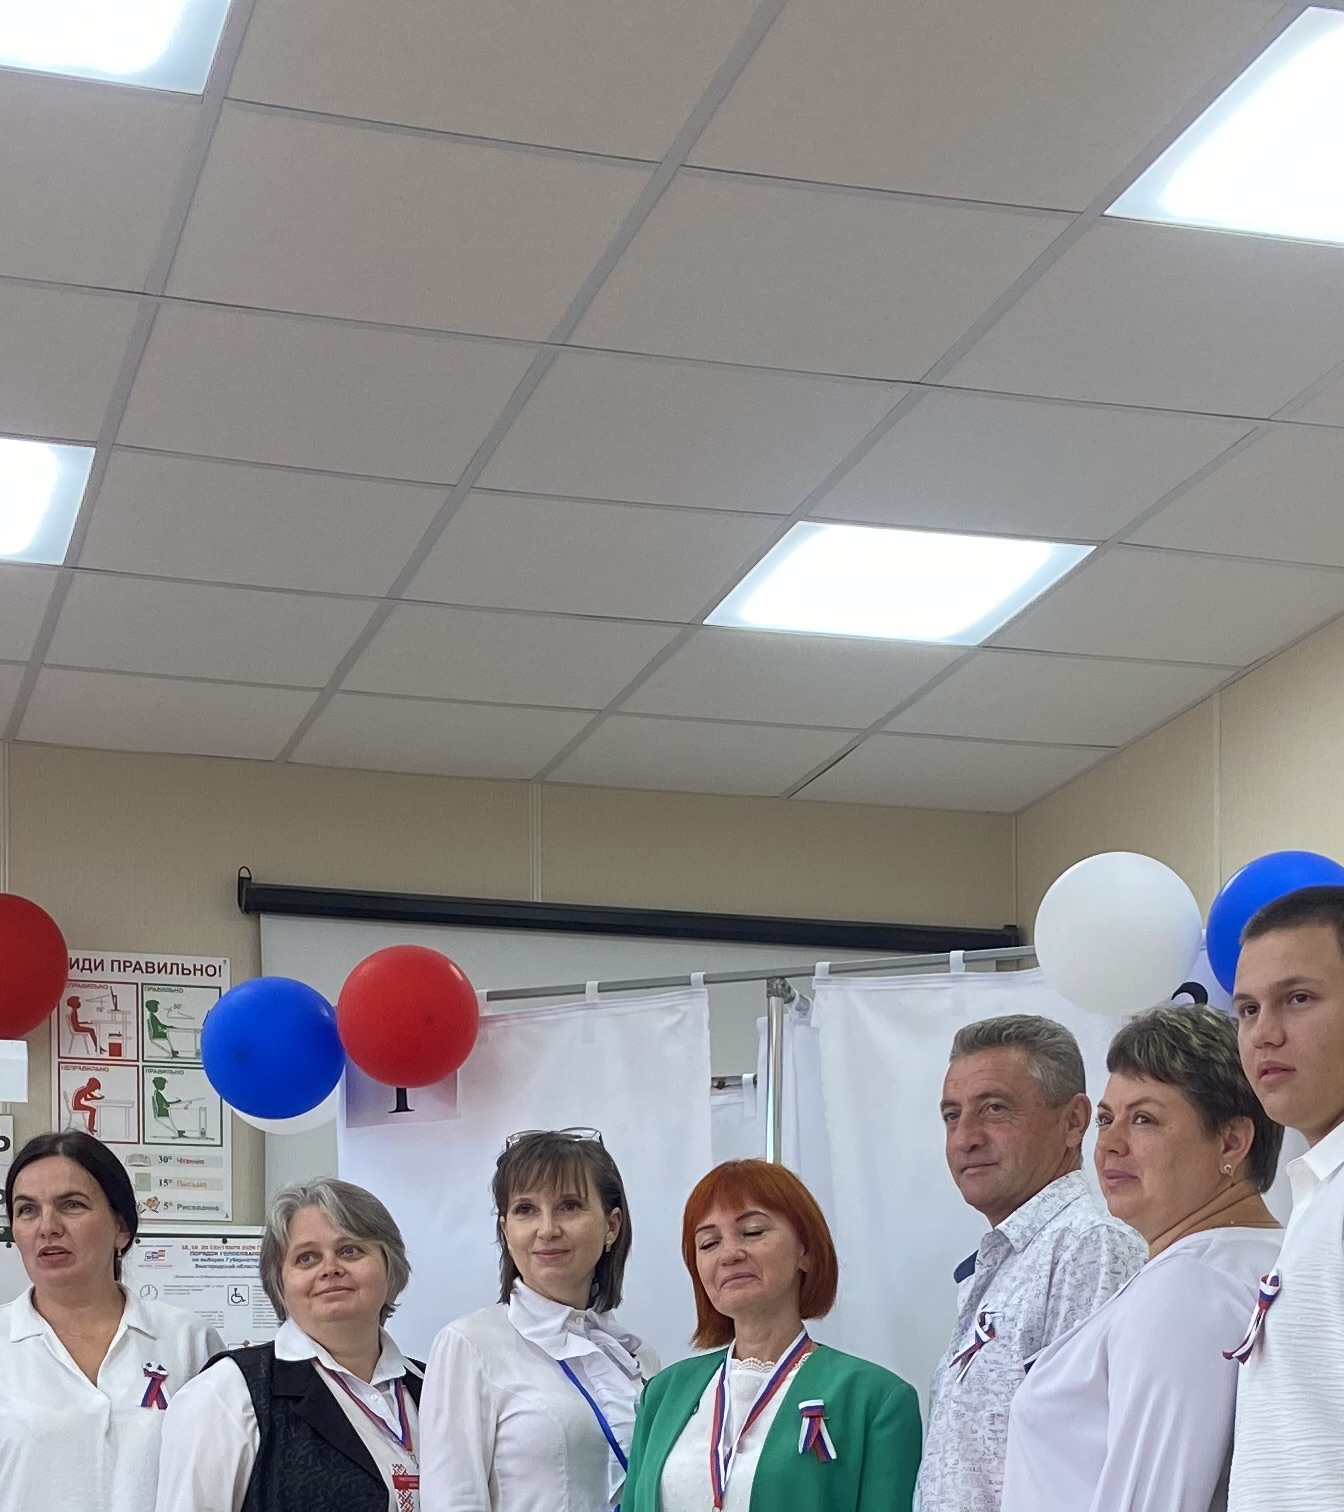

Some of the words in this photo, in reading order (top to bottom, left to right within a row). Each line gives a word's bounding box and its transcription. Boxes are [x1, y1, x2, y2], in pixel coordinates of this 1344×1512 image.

[69, 957, 105, 974] ИДИ
[110, 959, 222, 978] ПРАВИЛЬНО!
[68, 982, 108, 990] ПРАВИЛЬНО
